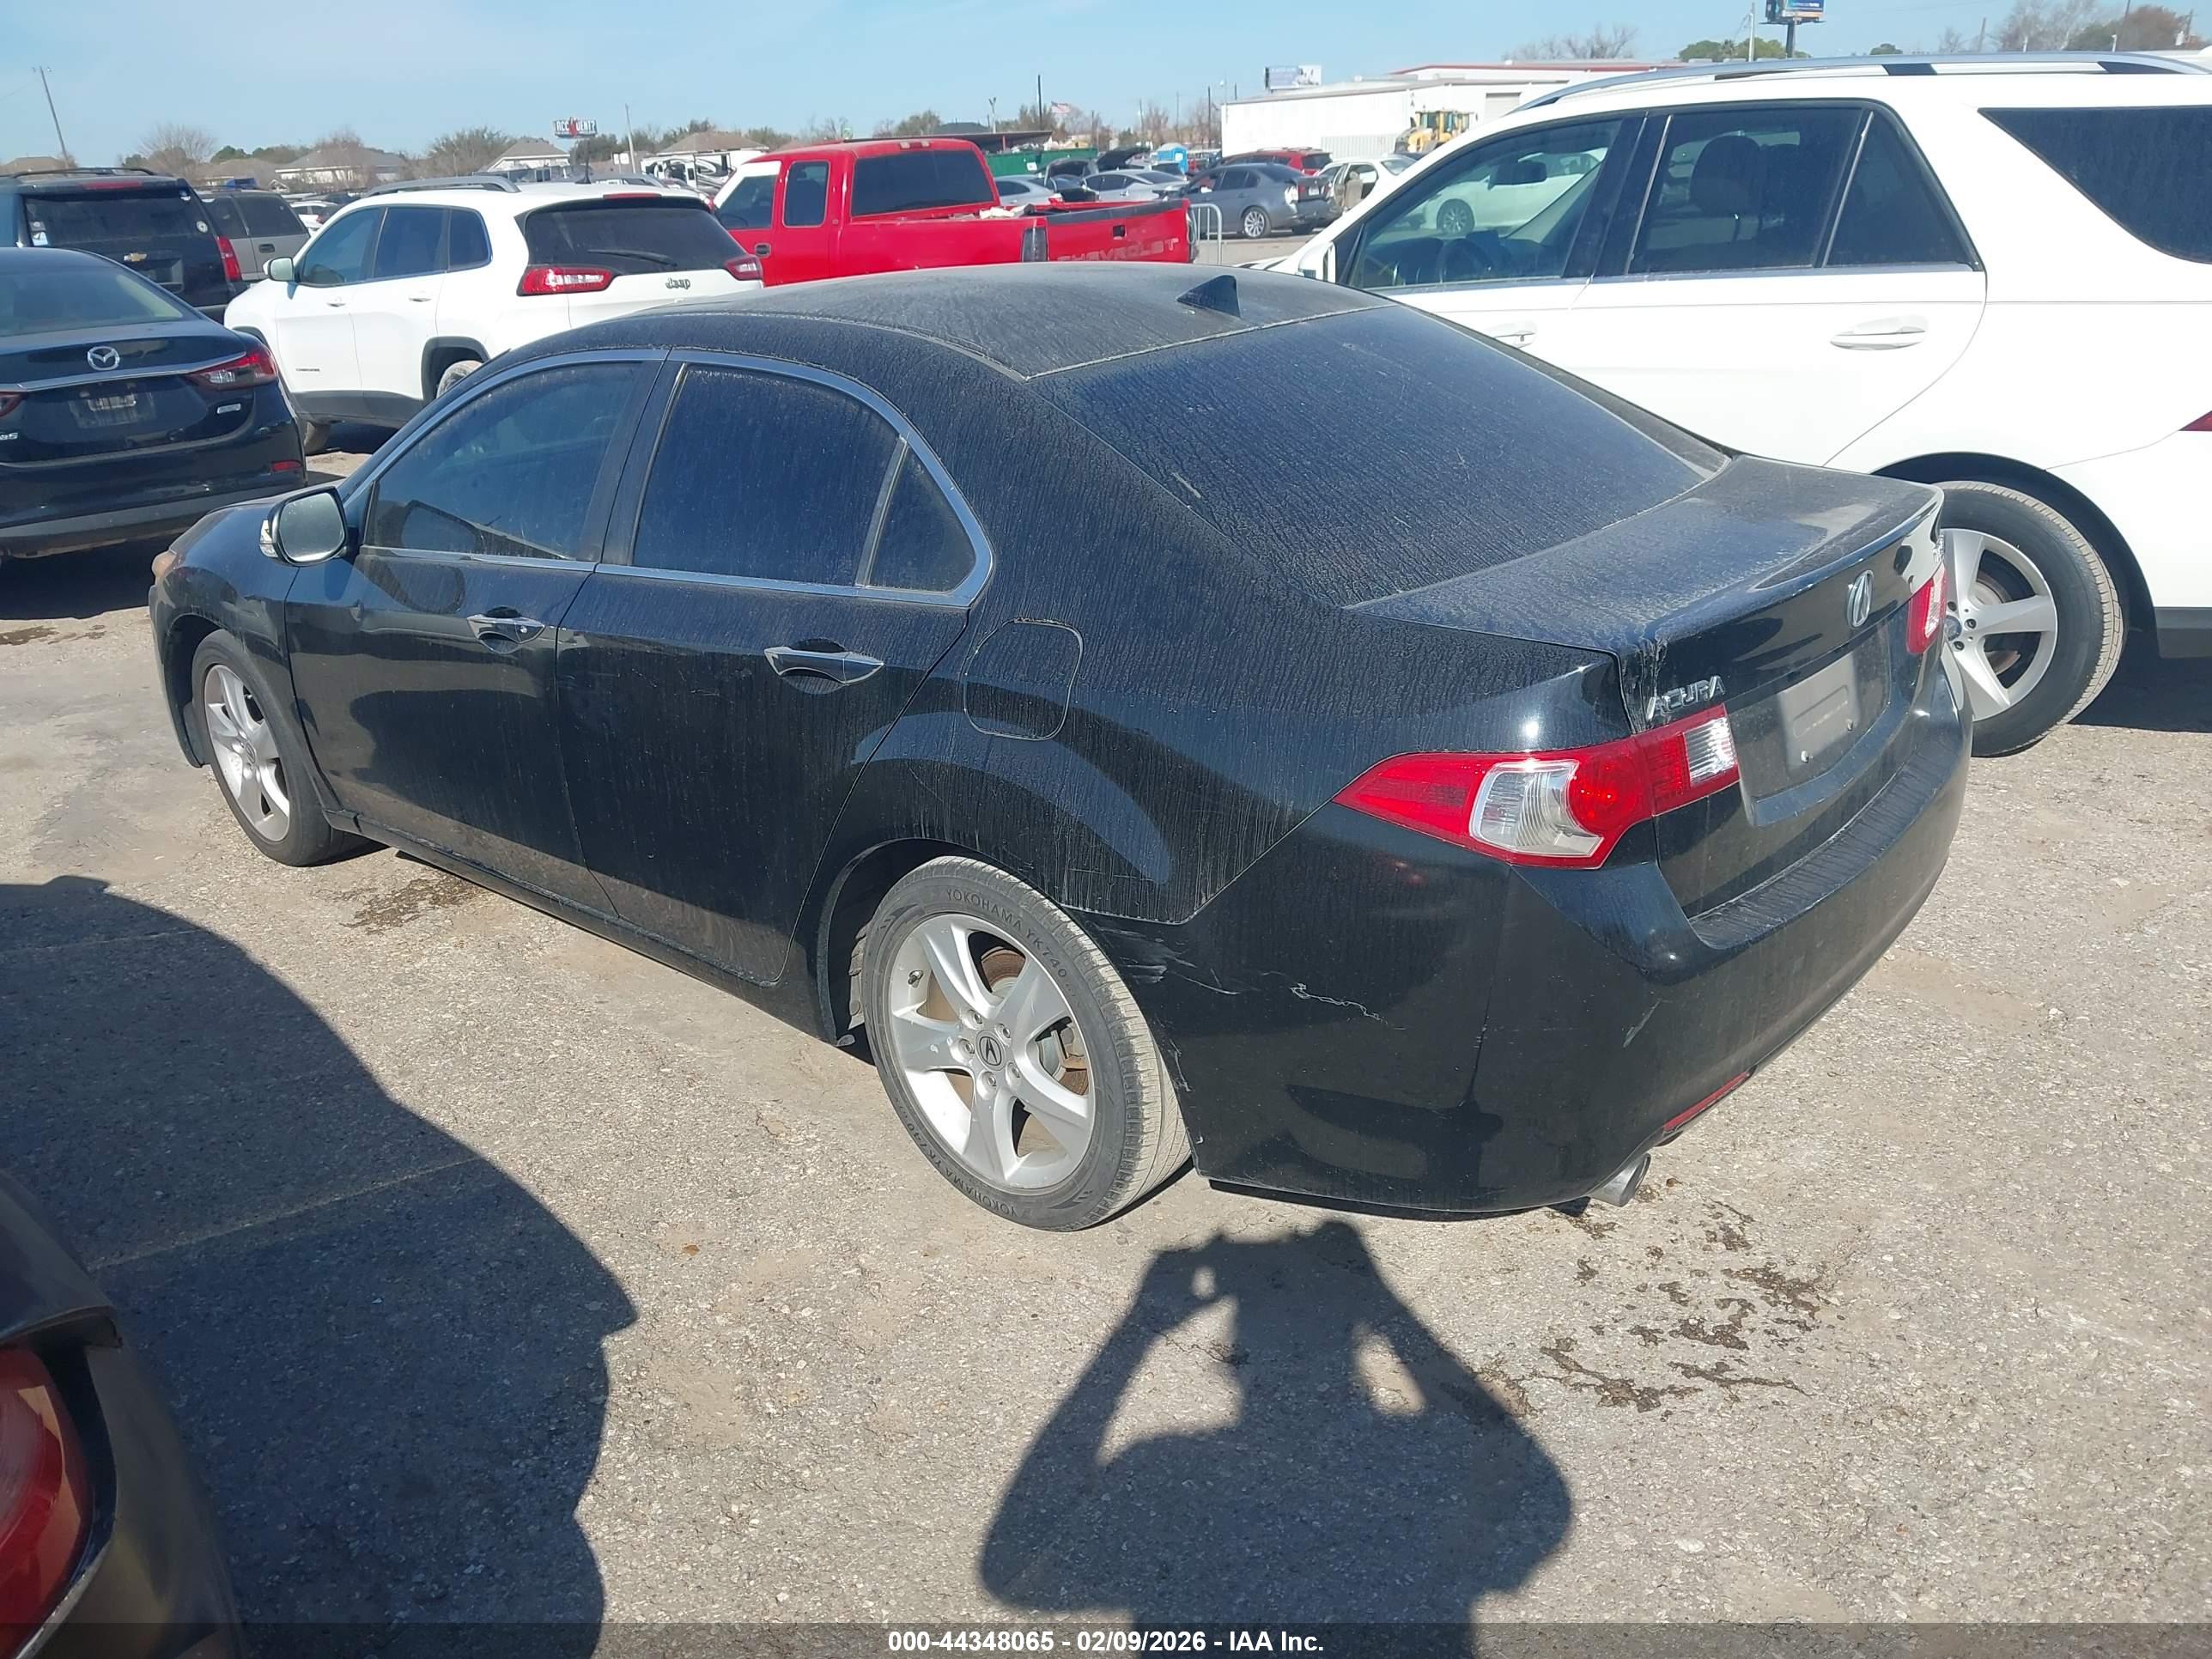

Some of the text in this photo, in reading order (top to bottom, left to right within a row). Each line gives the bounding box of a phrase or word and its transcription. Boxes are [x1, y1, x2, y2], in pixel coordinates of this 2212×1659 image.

[665, 277, 691, 289] Jeep
[1646, 675, 1726, 720] ACURA
[946, 888, 1067, 978] YOKOHAMA YK740
